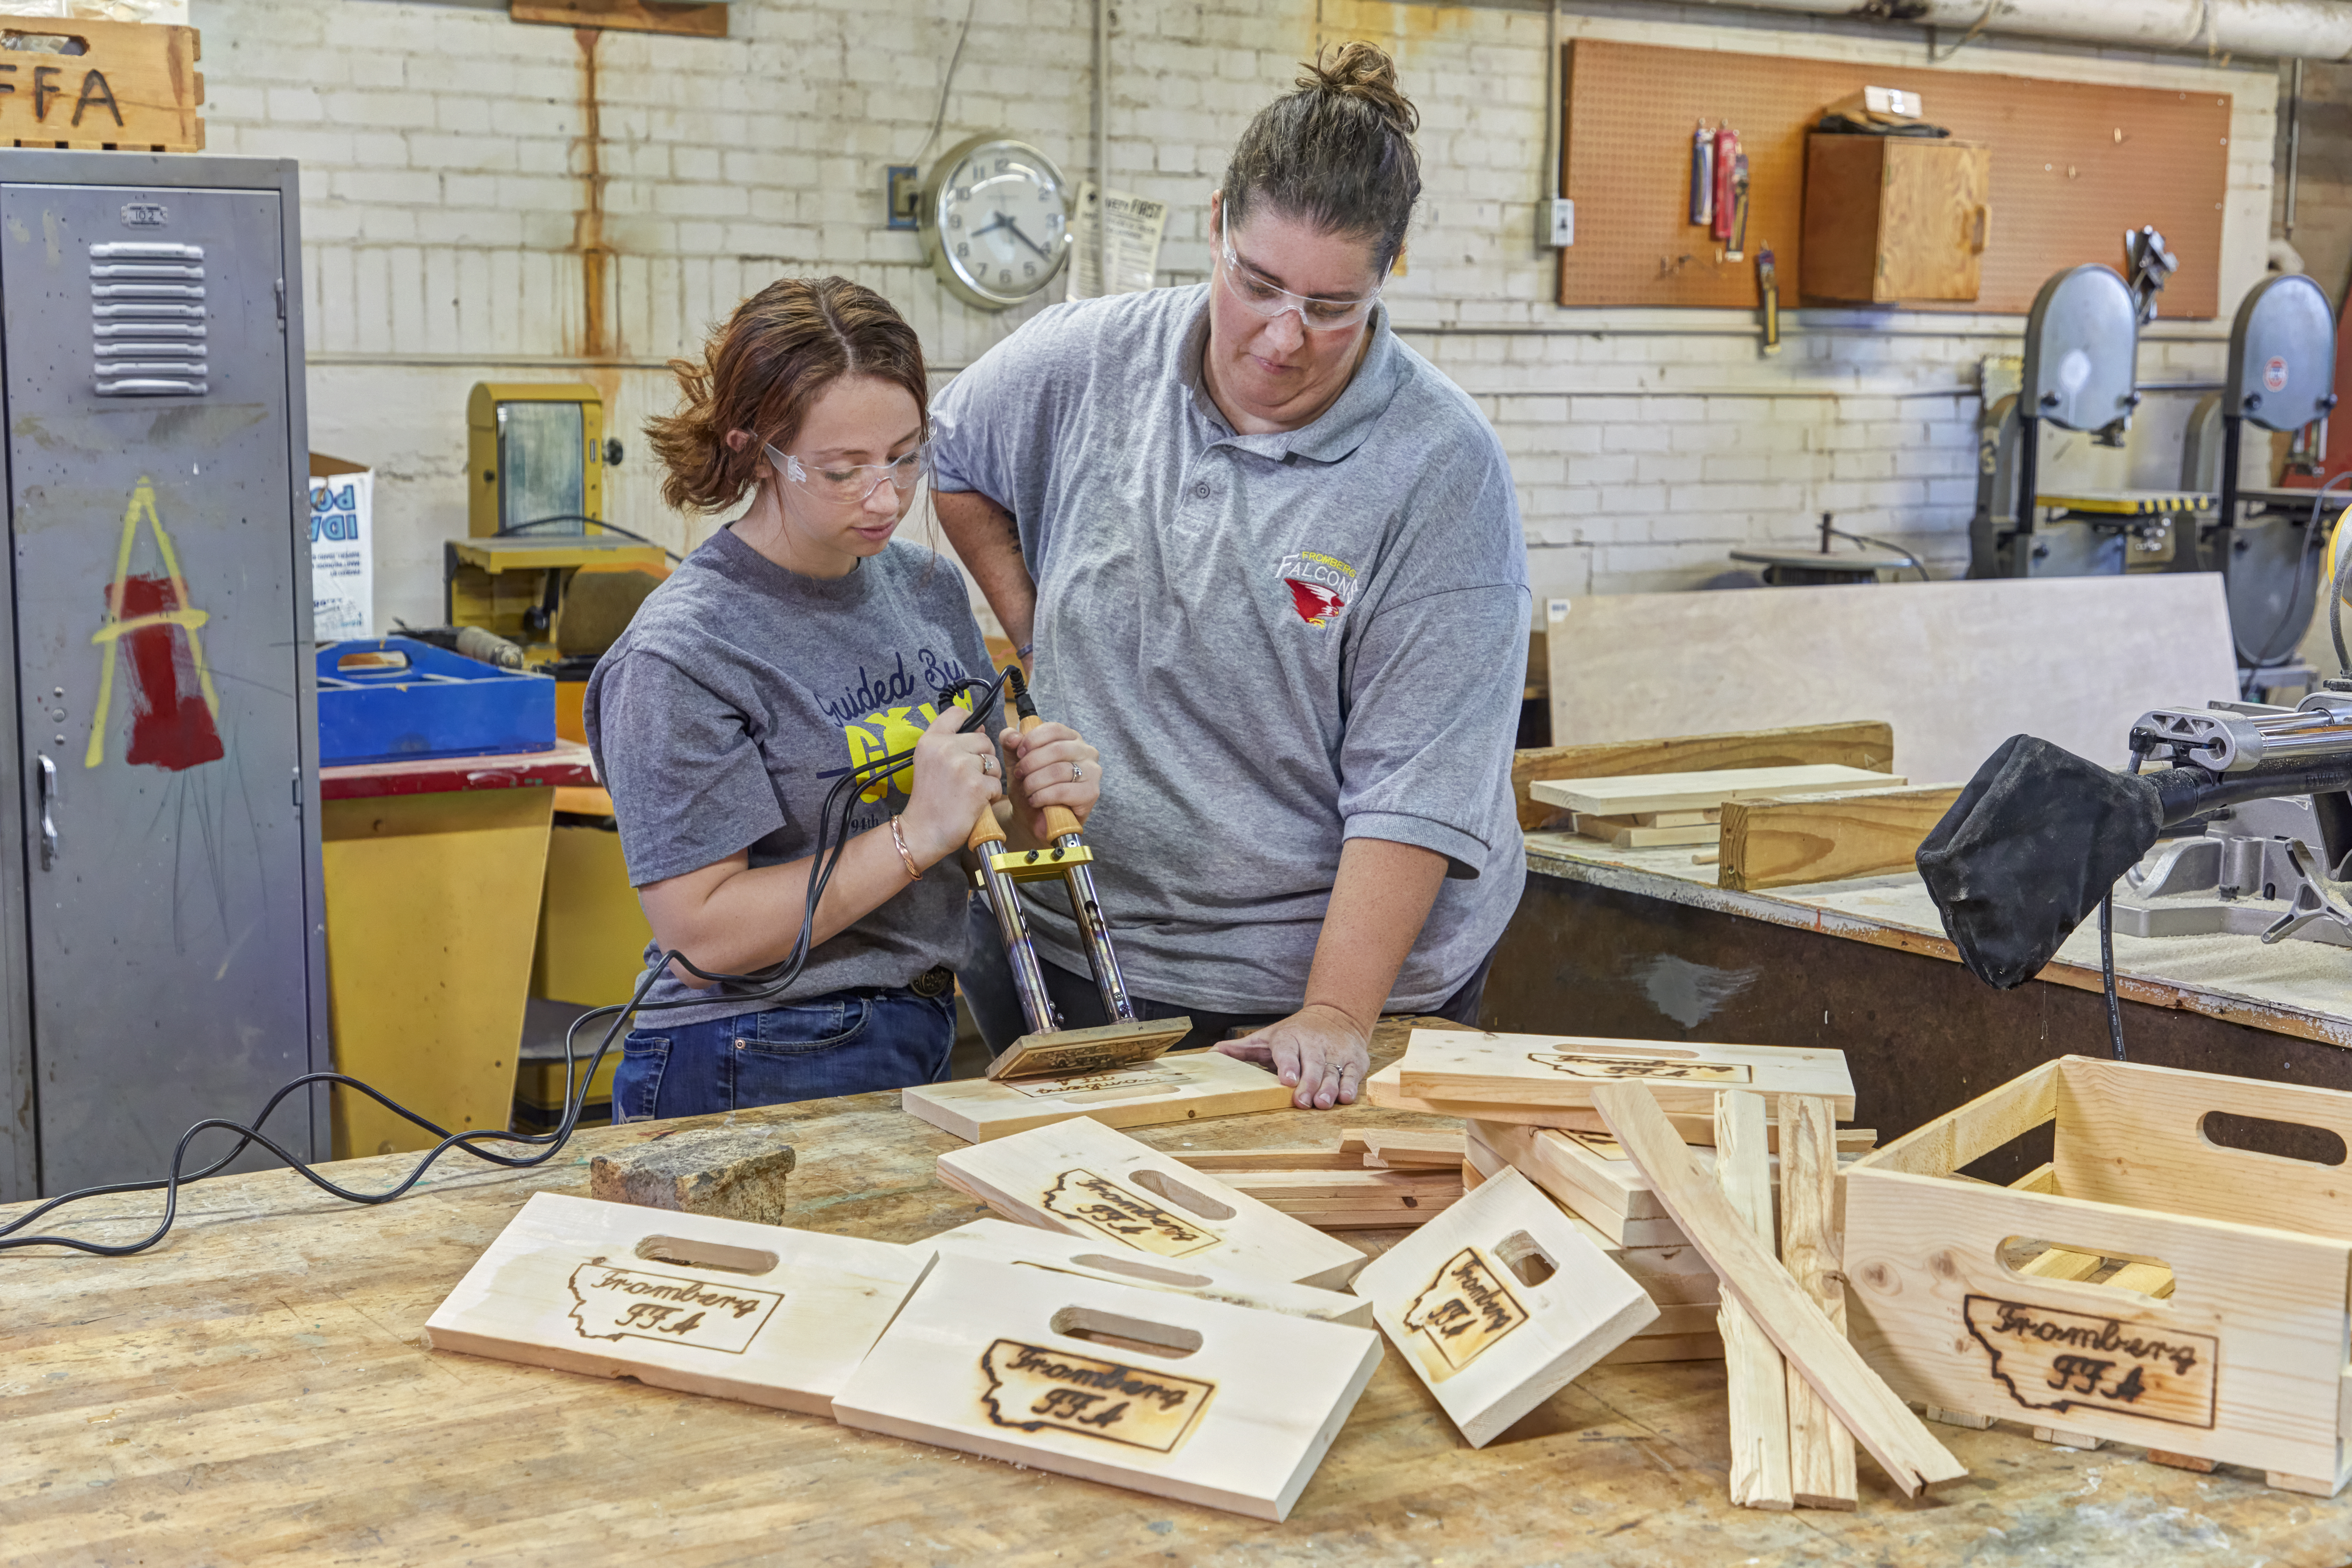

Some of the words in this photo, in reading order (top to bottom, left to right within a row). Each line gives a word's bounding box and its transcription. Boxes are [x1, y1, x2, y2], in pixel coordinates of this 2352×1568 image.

[973, 166, 985, 179] 11
[956, 186, 972, 200] 10
[1039, 186, 1050, 201] 2
[135, 210, 154, 221] 102
[951, 214, 961, 229] 9
[1046, 213, 1058, 228] 3
[957, 242, 969, 257] 8
[977, 262, 988, 277] 7
[999, 269, 1012, 284] 6
[1023, 261, 1036, 277] 5
[1302, 551, 1357, 578] FROMBERG
[1274, 553, 1358, 605] FALCONS
[851, 814, 879, 833] 94th
[1554, 1055, 1734, 1072] Fromberg
[1604, 1066, 1691, 1077] FFA
[1075, 1179, 1200, 1241] Fromberg
[1077, 1204, 1152, 1234] FFA
[590, 1269, 760, 1319] Fromberg
[1451, 1260, 1512, 1334] Fromberg
[615, 1303, 706, 1335] FFA
[1428, 1298, 1478, 1340] FFA
[1992, 1304, 2197, 1376] Fromberg
[1005, 1347, 1188, 1412] Fromberg
[2047, 1354, 2146, 1403] FFA
[1031, 1388, 1130, 1428] FFA
